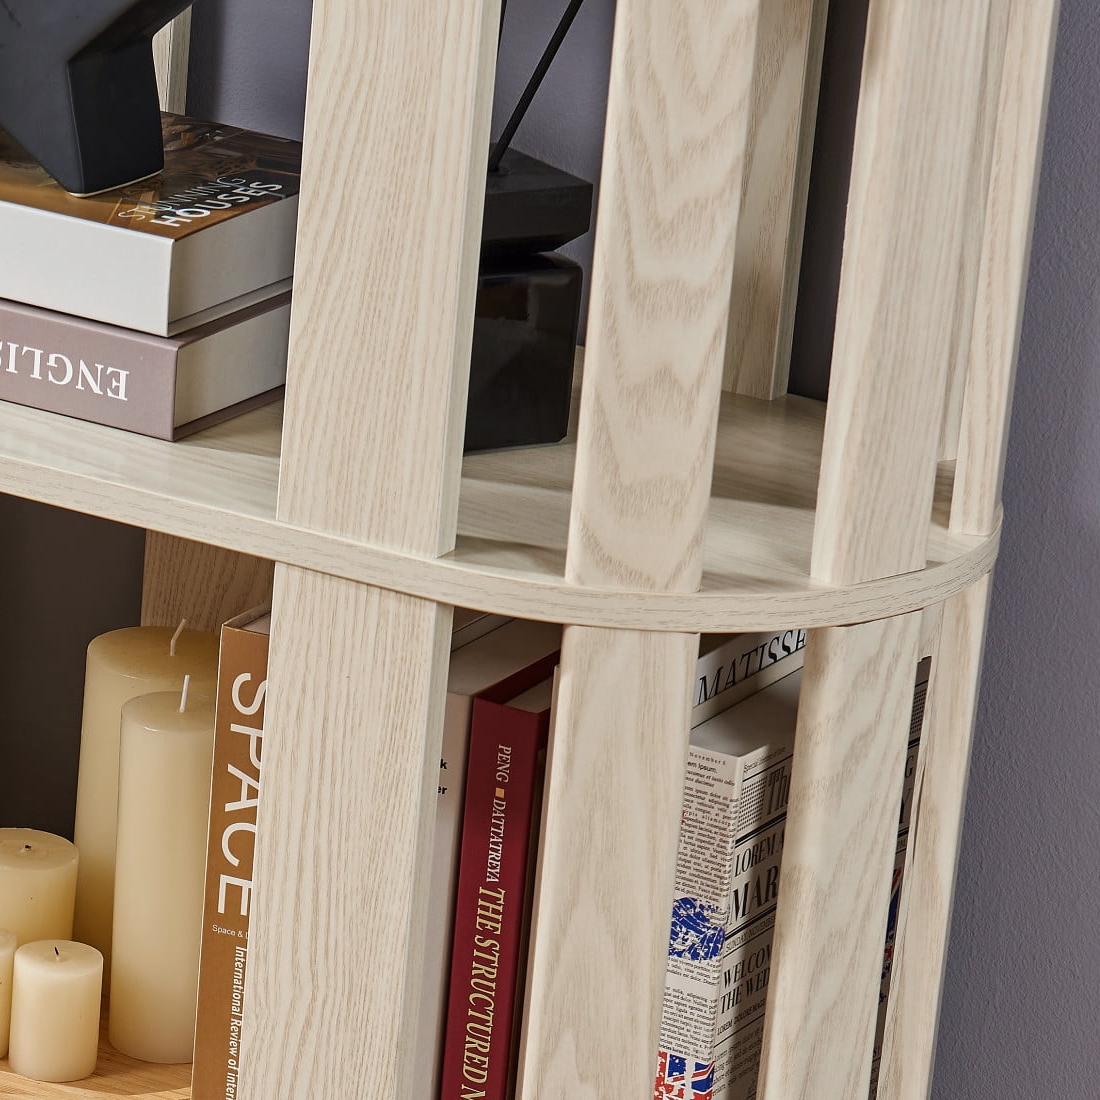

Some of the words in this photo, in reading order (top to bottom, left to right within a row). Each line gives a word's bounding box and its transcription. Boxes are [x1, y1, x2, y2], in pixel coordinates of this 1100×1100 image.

[149, 180, 284, 228] HOUSES
[696, 629, 806, 706] MATISSE
[495, 743, 512, 783] PENG
[217, 672, 268, 916] SPACE
[486, 797, 507, 883] DATTATREYA
[212, 924, 236, 938] Space
[475, 886, 507, 935] THE
[230, 945, 248, 1016] International
[720, 983, 744, 1014] THE
[461, 934, 501, 1085] STRUCTURED
[228, 1017, 243, 1057] Review
[226, 1058, 240, 1071] of
